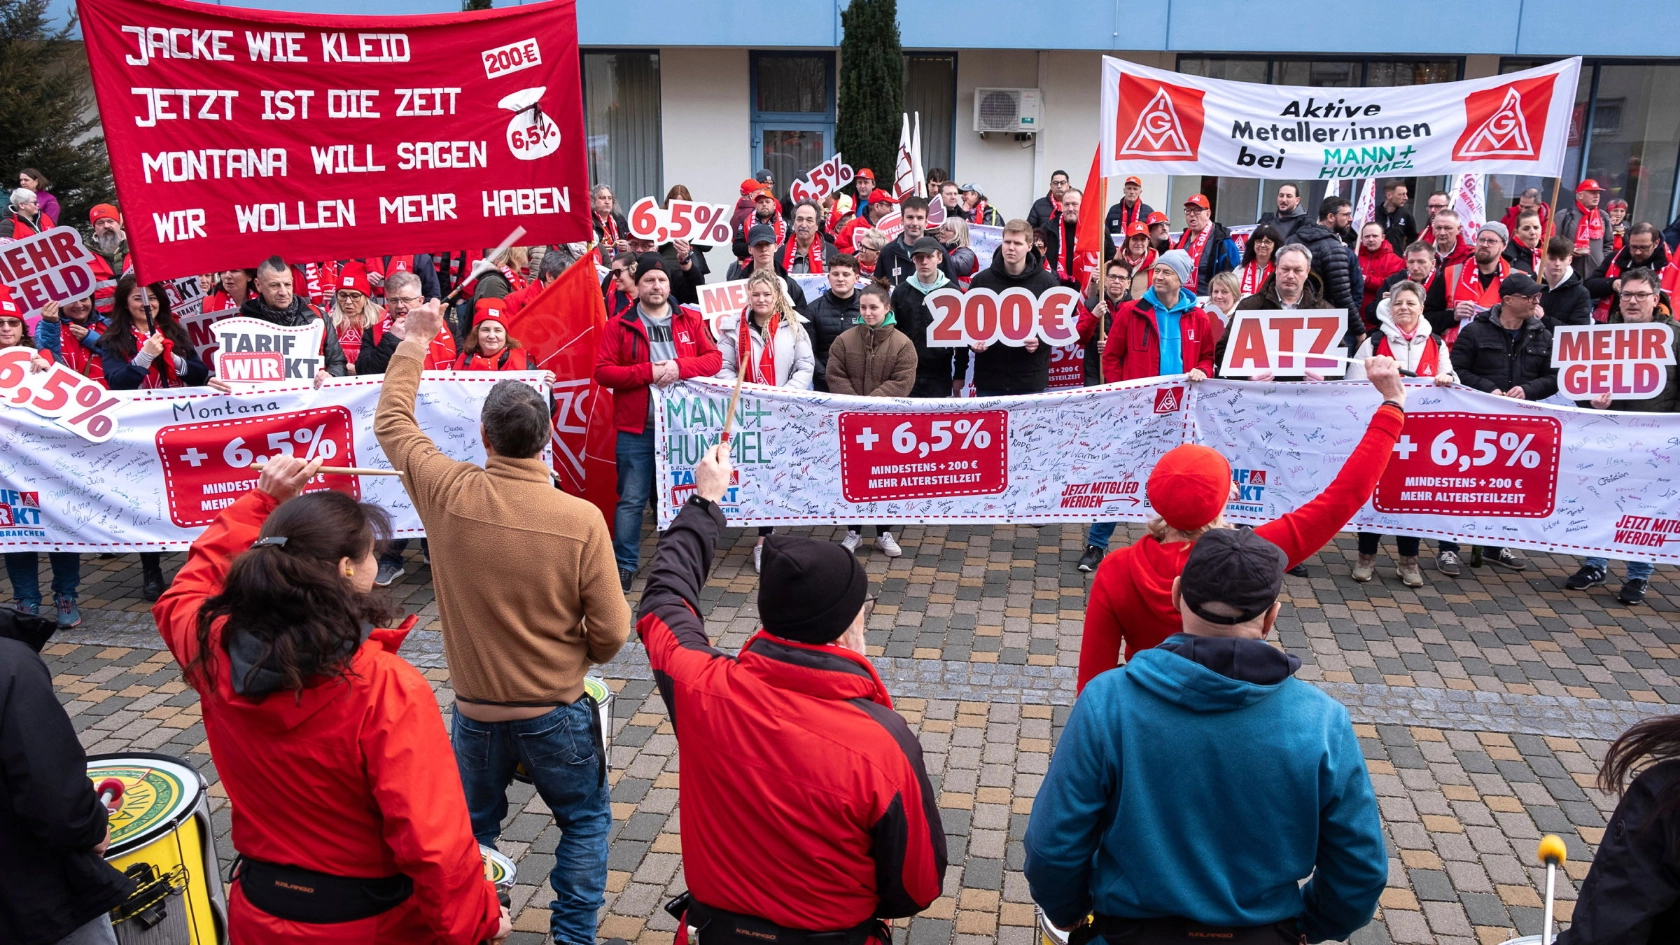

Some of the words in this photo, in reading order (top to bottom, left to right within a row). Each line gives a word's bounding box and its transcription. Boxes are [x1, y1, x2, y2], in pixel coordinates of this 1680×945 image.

[122, 25, 234, 66] JACKE
[245, 31, 308, 62] WIE
[321, 32, 411, 63] KLEID
[484, 42, 539, 74] 200€
[131, 87, 239, 128] JETZT
[260, 89, 314, 121] IST
[327, 89, 380, 119] DIE
[394, 87, 462, 117] ZEIT
[1279, 98, 1381, 118] Aktive
[511, 122, 556, 151] 6,5%
[1231, 120, 1431, 143] Metaller/innen
[141, 148, 287, 184] MONTANA
[310, 144, 386, 175] WILL
[396, 141, 487, 170] SAGEN
[1236, 146, 1285, 169] bei
[1324, 145, 1417, 165] MANN+
[1318, 159, 1415, 179] HUMMEL
[792, 158, 851, 204] 6,5%
[152, 208, 207, 243] WIR
[234, 199, 356, 234] WOLLEN
[379, 193, 458, 224] MEHR
[481, 186, 571, 218] HABEN
[632, 200, 729, 243] 6,5%
[166, 278, 201, 307] RKT
[702, 284, 750, 313] ME
[933, 293, 1072, 341] 200€
[220, 332, 296, 356] TARIF
[1229, 317, 1339, 368] ATZ
[1558, 328, 1667, 361] MEHR
[225, 358, 319, 380] WIRKT
[1564, 363, 1660, 395] GELD
[0, 351, 120, 437] 6,5%
[172, 401, 280, 422] Montana
[667, 397, 772, 428] MANN+
[179, 447, 209, 467] +
[222, 424, 337, 472] 6,5%
[856, 427, 879, 451] +
[892, 418, 991, 458] 6,5%
[1392, 434, 1417, 460] +
[1429, 428, 1541, 472] 6,5%
[871, 462, 937, 475] MINDESTENS
[947, 461, 969, 471] 200
[971, 460, 978, 469] €
[202, 478, 260, 495] MINDEST
[868, 477, 898, 489] MEHR
[900, 473, 982, 488] ALTERSTEILZEIT
[1061, 483, 1091, 497] JETZT
[1090, 481, 1140, 495] MITGLIED
[1405, 476, 1477, 488] MINDESTENS
[1489, 478, 1513, 488] 200
[1515, 478, 1523, 489] €
[201, 498, 236, 511] MEHR
[1060, 495, 1104, 508] WERDEN
[1400, 490, 1433, 501] MEHR
[1434, 491, 1526, 504] ALTERSTEILZEIT
[0, 507, 41, 526] RKT
[1615, 514, 1652, 530] JETZT
[1613, 529, 1667, 547] WERDEN
[275, 880, 314, 893] KALANGO
[736, 928, 776, 940] KALANGO
